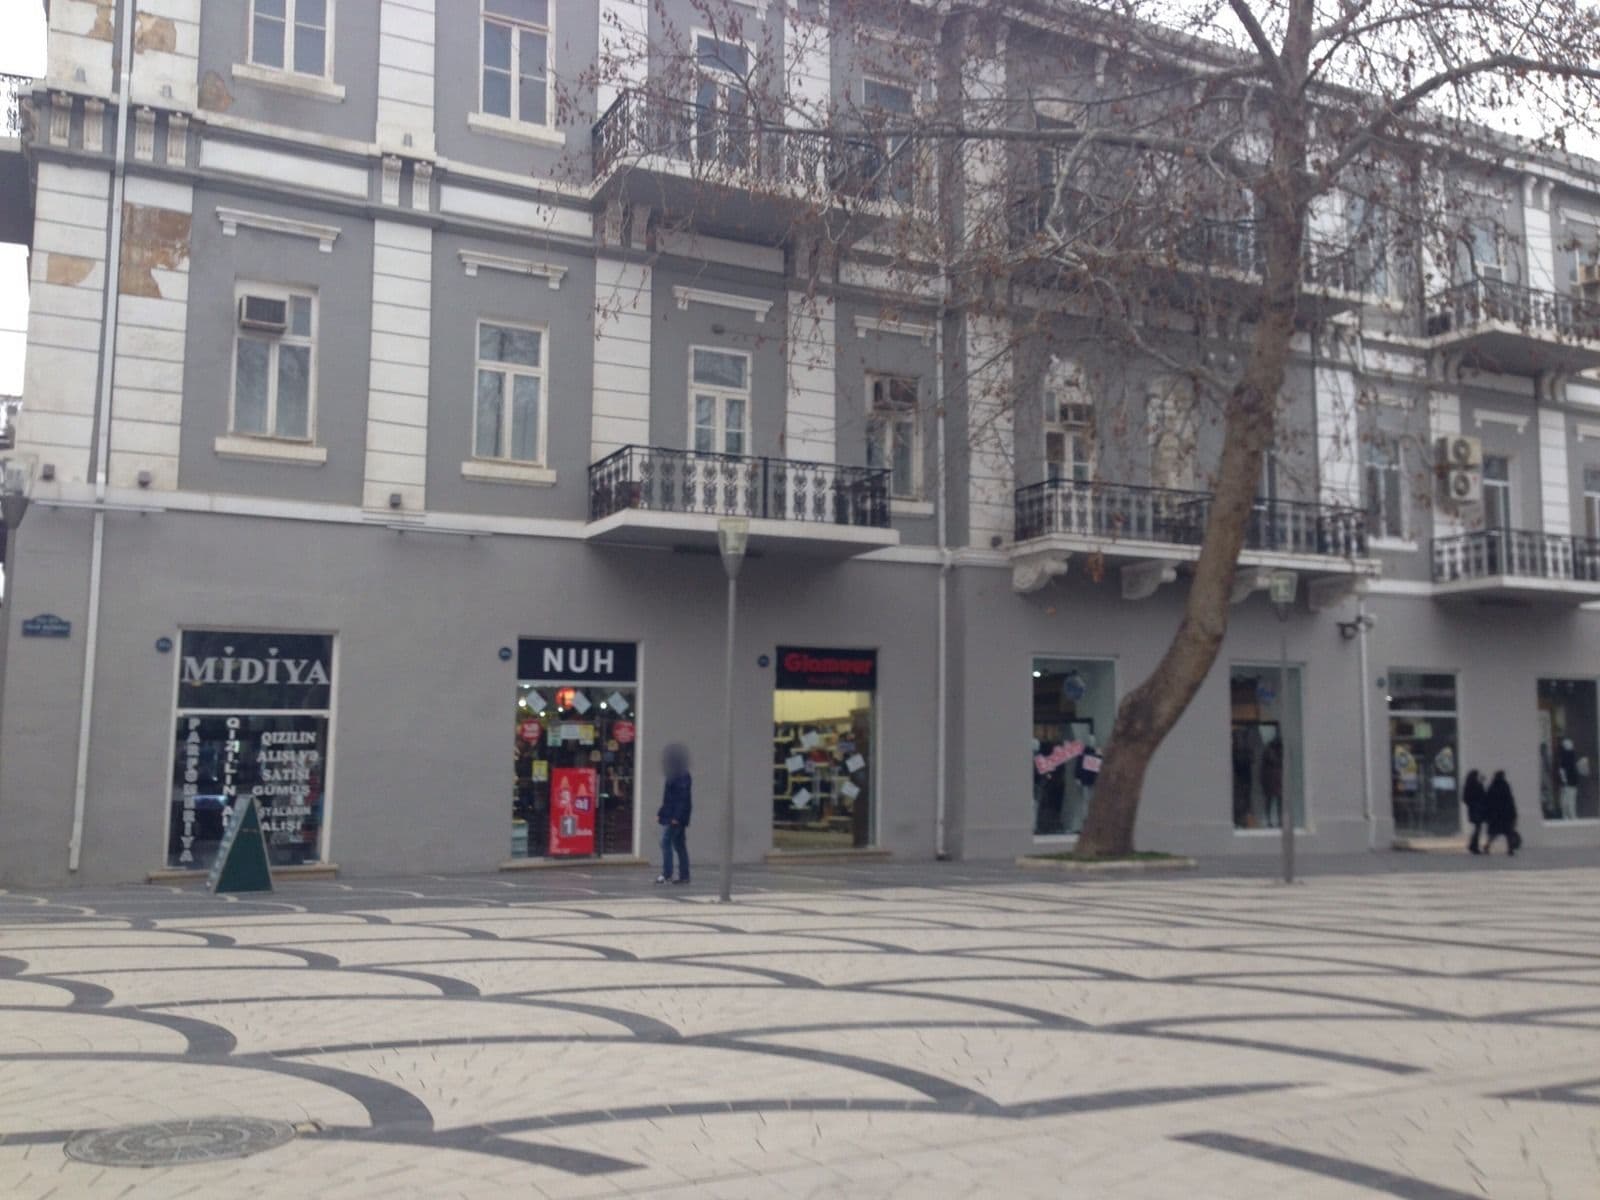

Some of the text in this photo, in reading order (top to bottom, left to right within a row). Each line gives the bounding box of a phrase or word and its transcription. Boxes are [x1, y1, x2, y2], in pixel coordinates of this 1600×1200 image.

[181, 646, 330, 685] MİDİYA
[543, 647, 614, 673] NUH
[261, 731, 316, 746] QIZILIN
